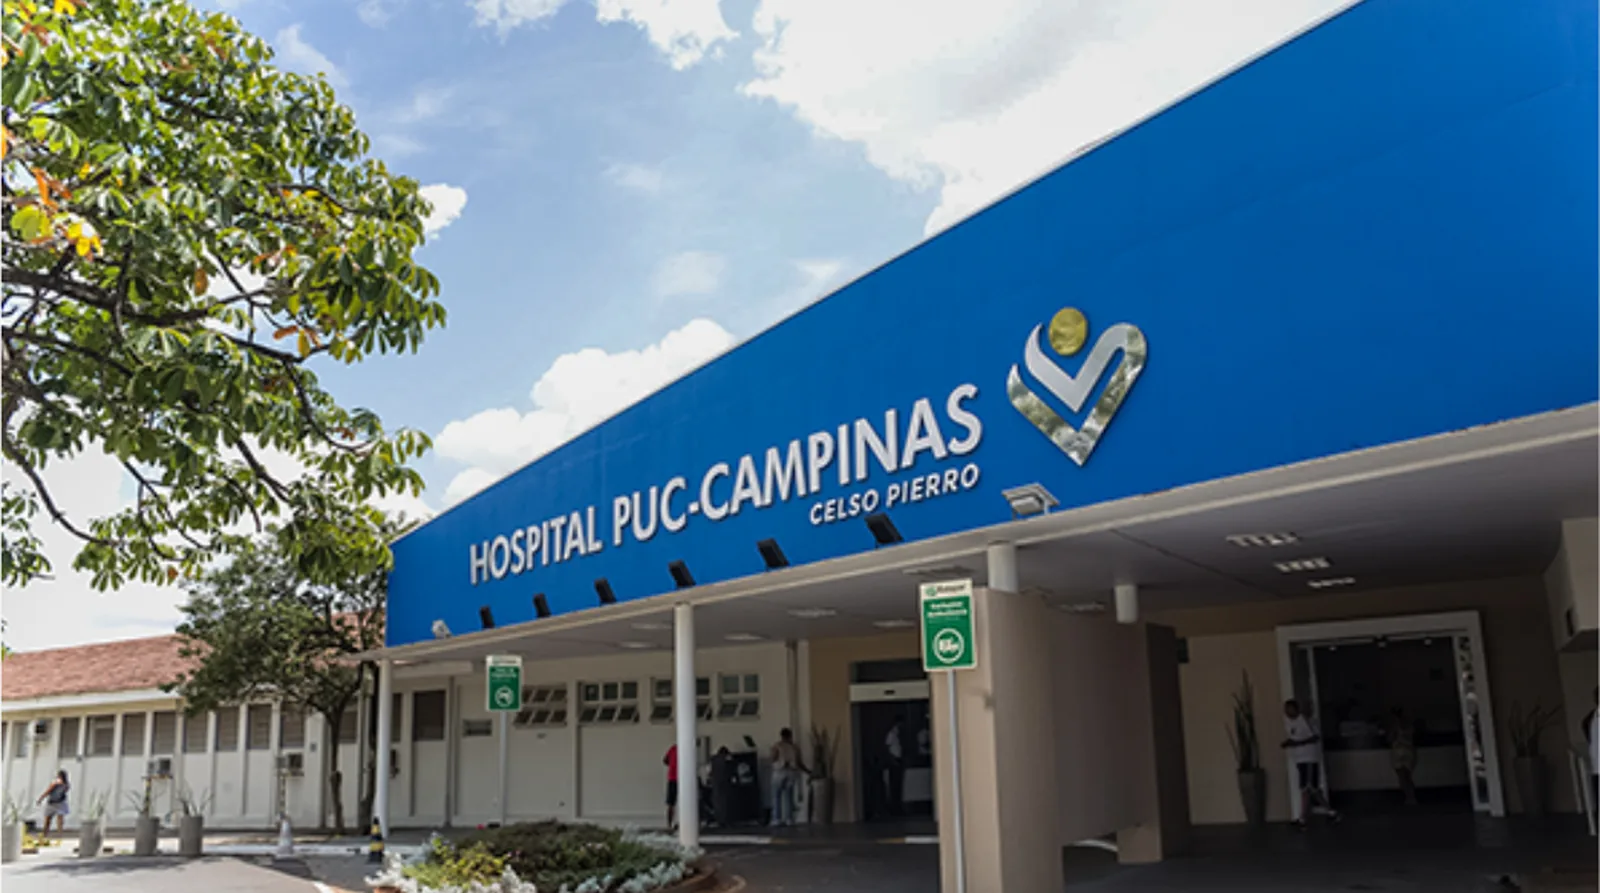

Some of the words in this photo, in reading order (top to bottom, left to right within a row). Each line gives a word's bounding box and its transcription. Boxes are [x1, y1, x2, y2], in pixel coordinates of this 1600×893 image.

[469, 505, 603, 585] HOSPITAL
[612, 382, 983, 546] PUC-CAMPINAS
[809, 488, 879, 525] CELSO
[886, 463, 980, 508] PIERRO
